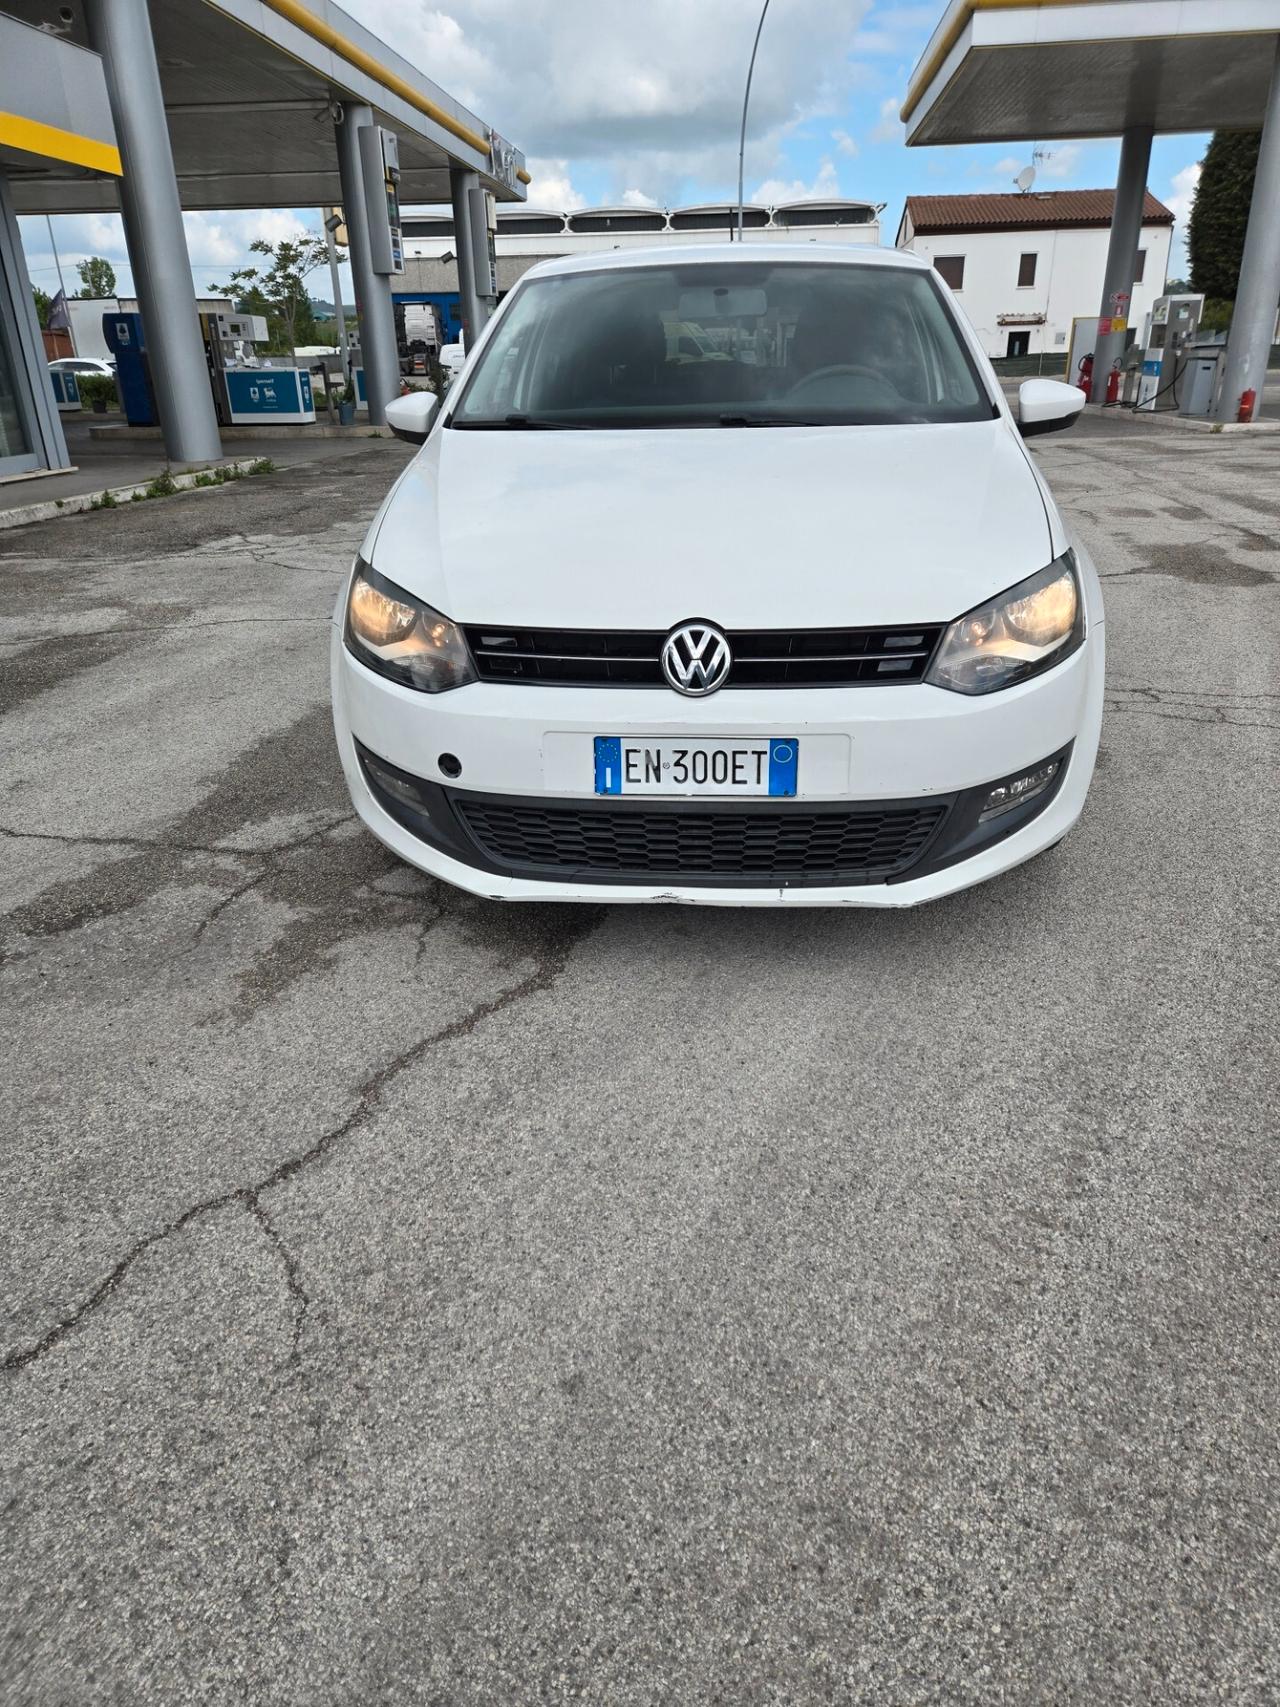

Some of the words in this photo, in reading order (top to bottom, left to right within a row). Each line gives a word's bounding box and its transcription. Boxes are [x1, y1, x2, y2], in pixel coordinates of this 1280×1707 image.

[665, 627, 728, 692] VW
[625, 748, 661, 784] EN
[673, 749, 768, 785] 300ET
